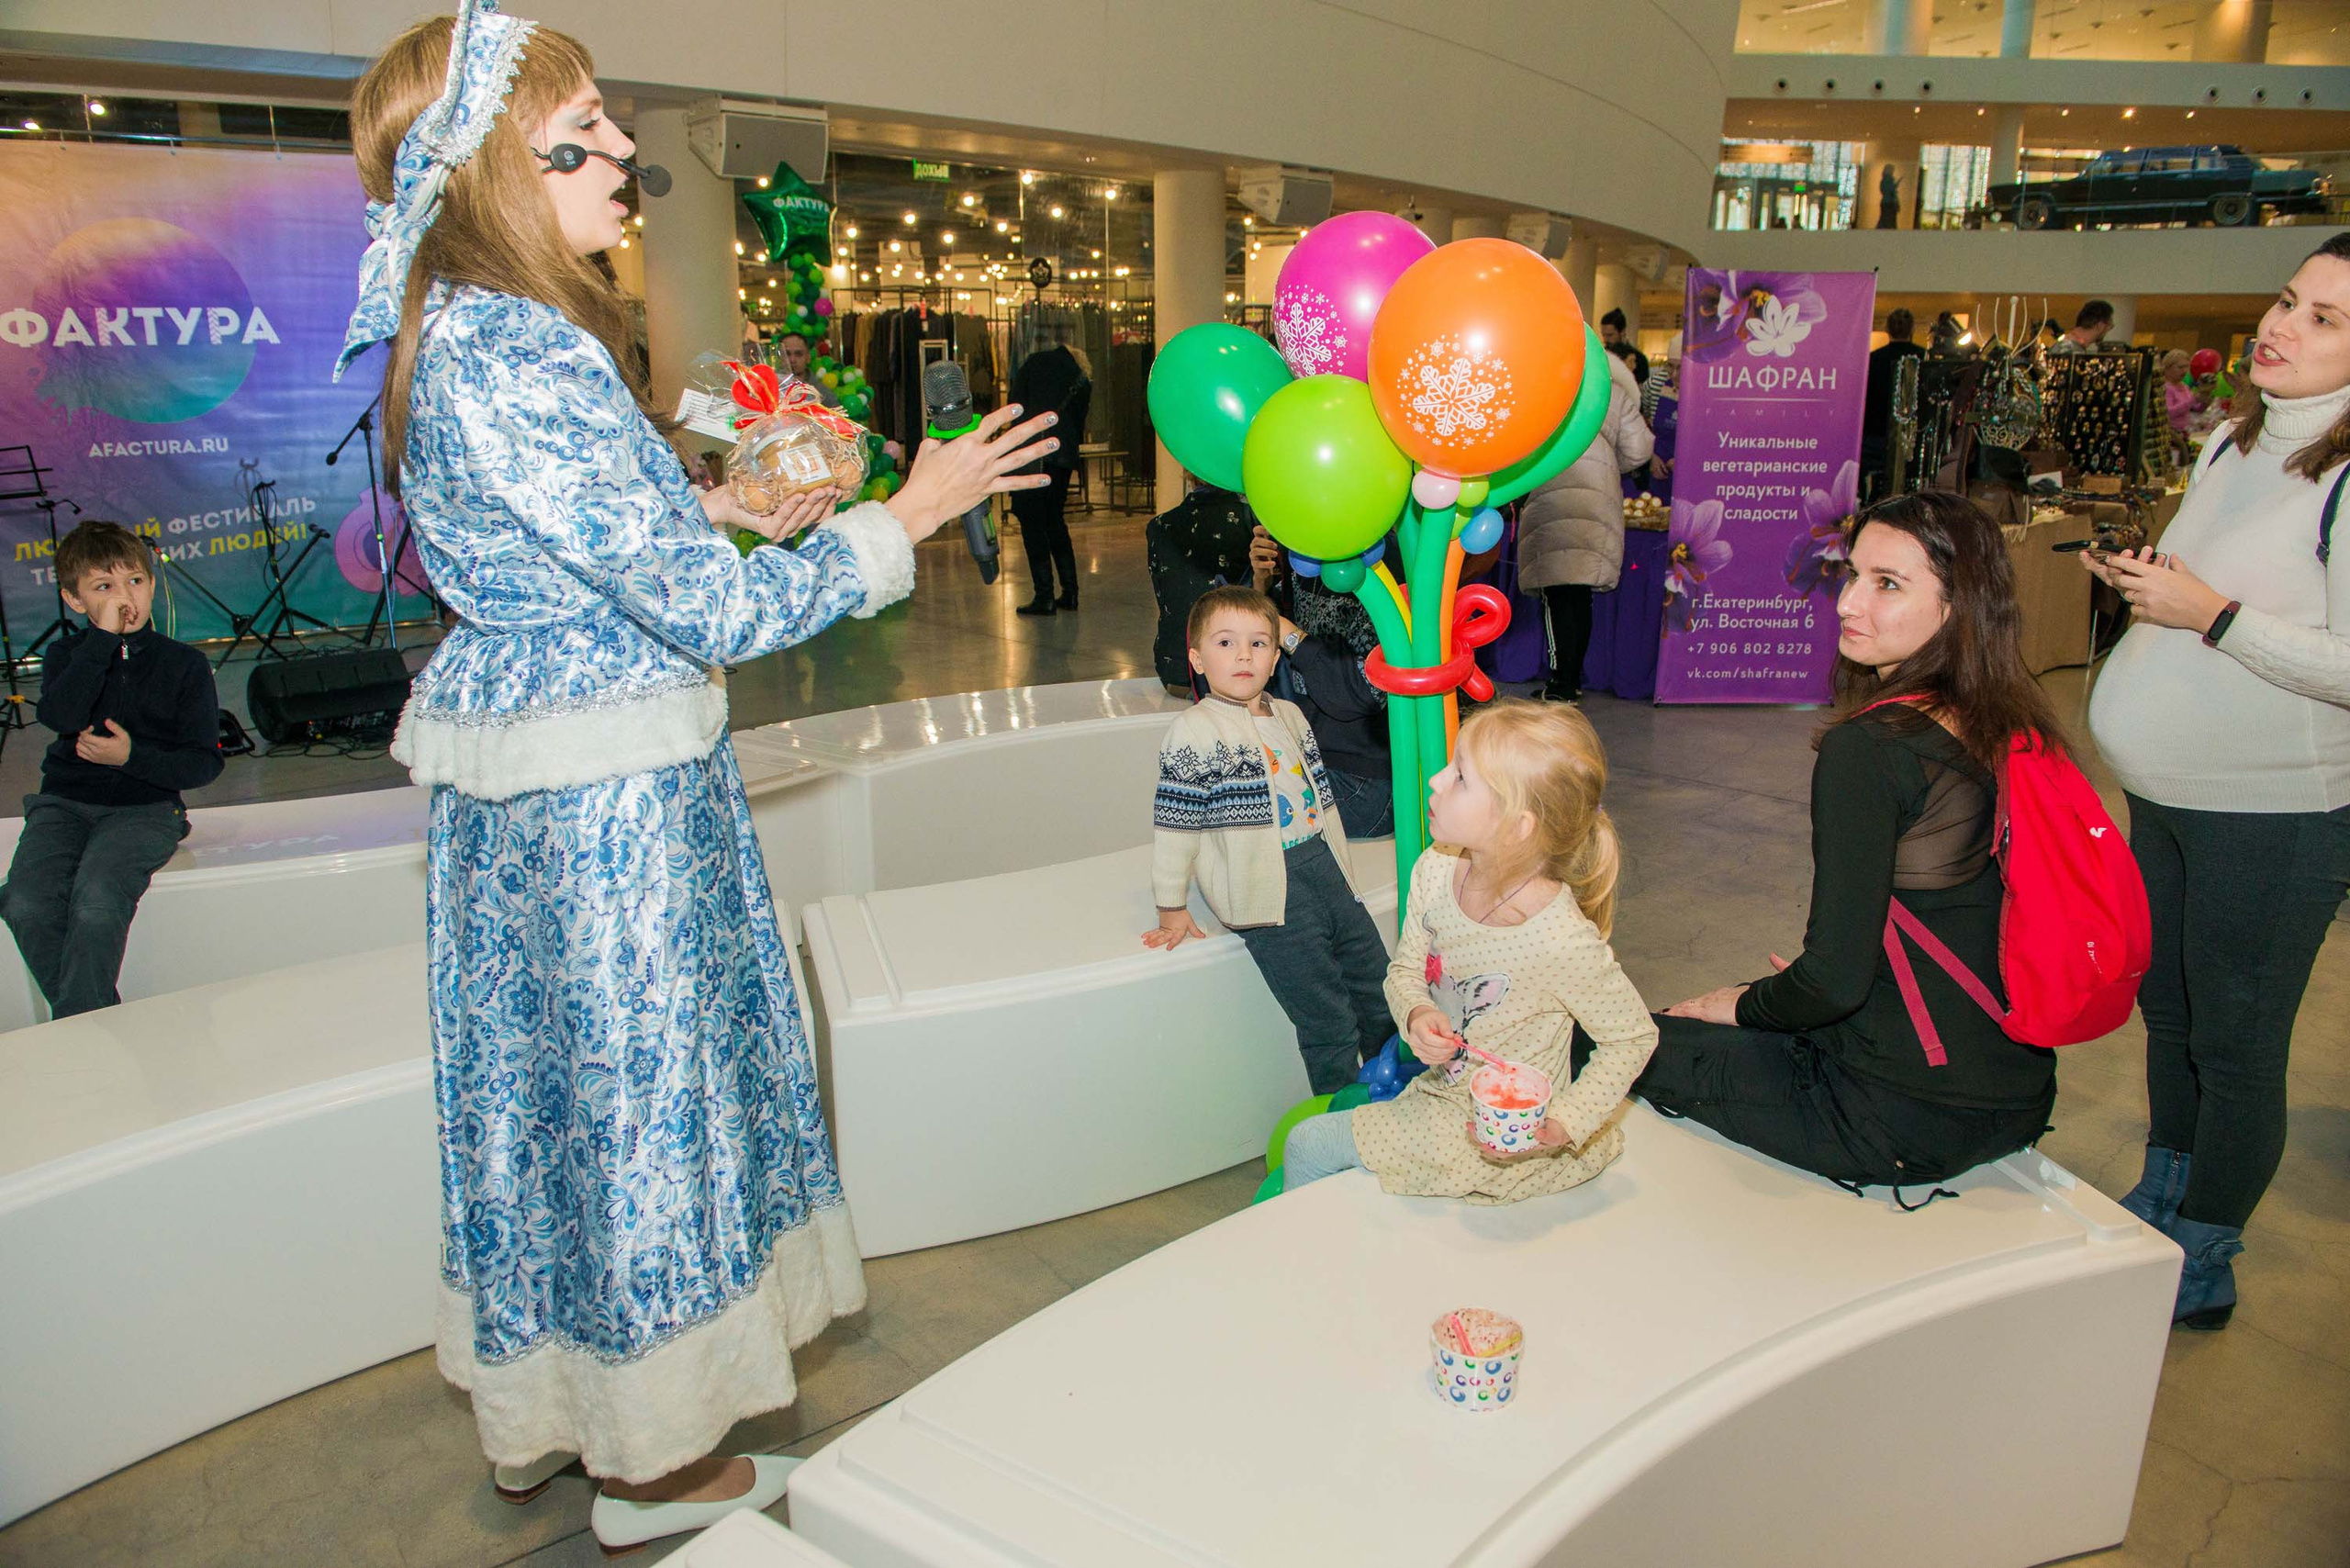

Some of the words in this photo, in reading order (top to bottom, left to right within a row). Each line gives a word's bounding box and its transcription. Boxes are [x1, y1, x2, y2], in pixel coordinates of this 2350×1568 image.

[0, 306, 281, 348] ФАКТУРА
[1708, 365, 1837, 392] ШАФРАН
[88, 437, 229, 458] AFACTURA.RU
[1718, 431, 1818, 450] Уникальные
[1703, 461, 1828, 477] вегетарианские
[1716, 485, 1796, 501] продукты
[1801, 486, 1811, 497] и
[1724, 509, 1798, 522] сладости
[1692, 593, 1814, 614] г.Екатеринбург,
[1690, 617, 1714, 633] ул.
[1718, 613, 1799, 629] Восточная
[1804, 613, 1815, 630] 6
[1687, 643, 1705, 655] +7
[1710, 643, 1738, 655] 906
[1743, 643, 1772, 655] 802
[1776, 643, 1813, 655] 8278
[1686, 666, 1809, 679] vk.com/shafranew
